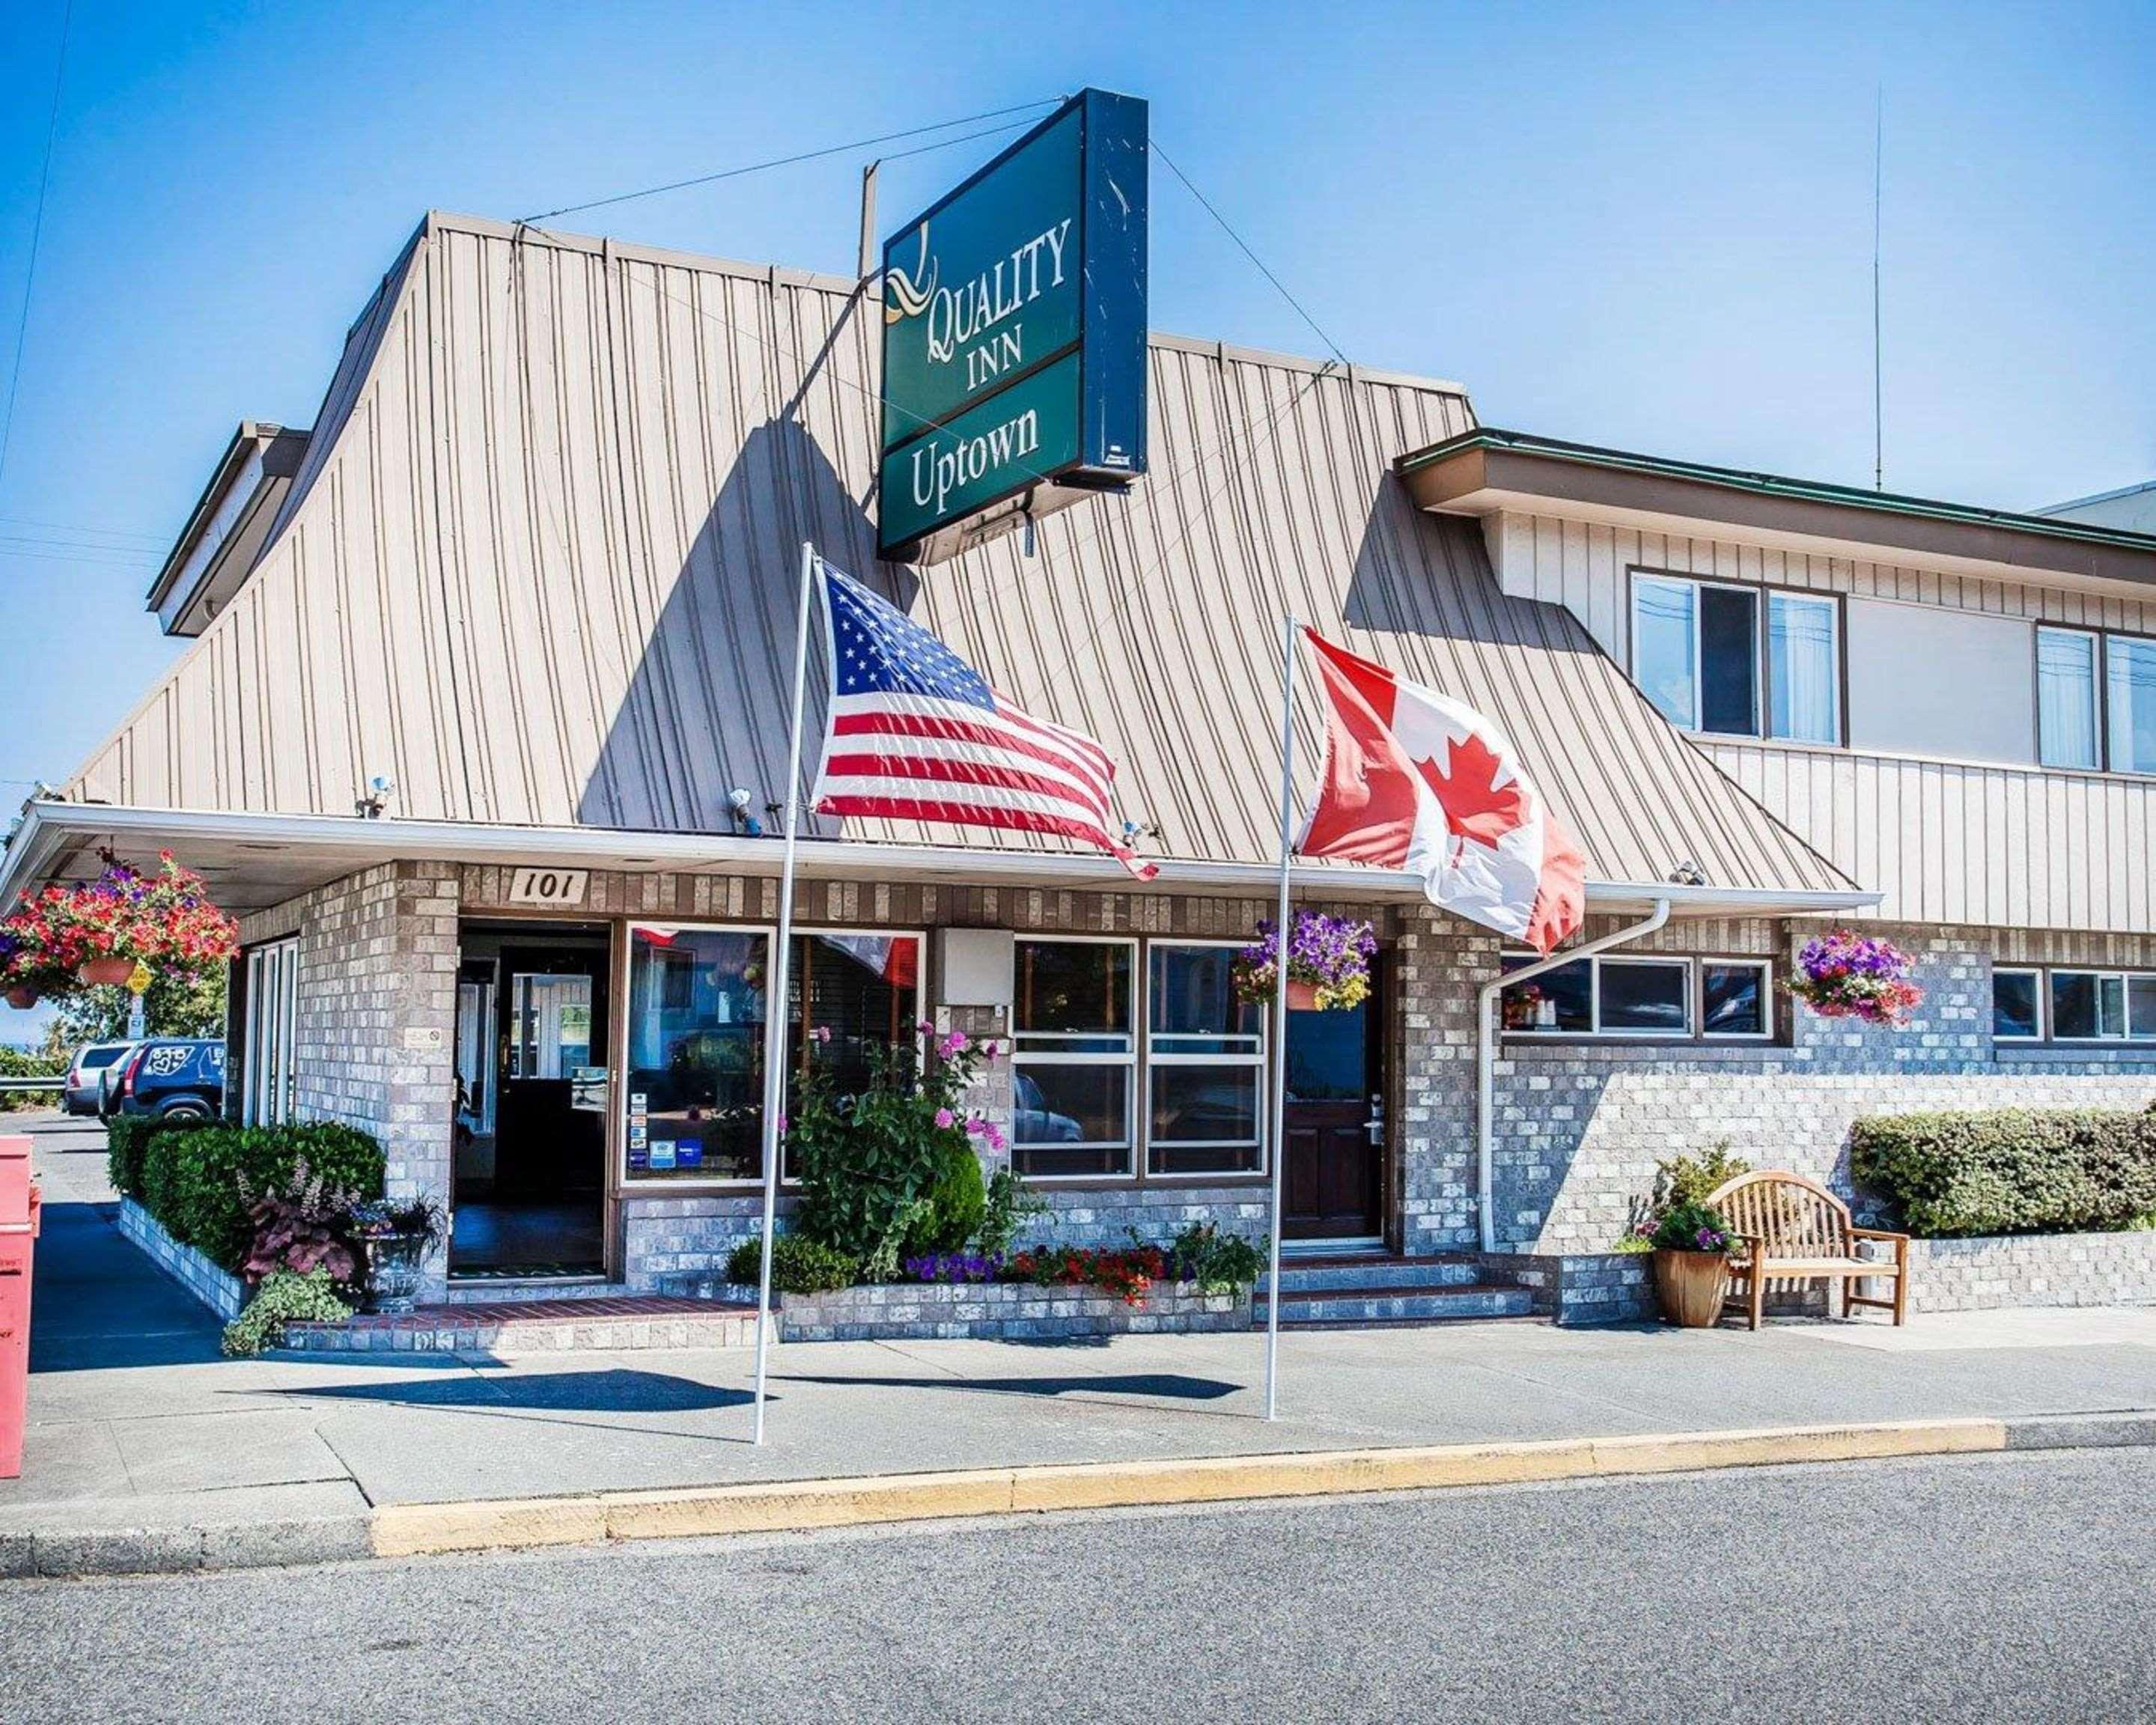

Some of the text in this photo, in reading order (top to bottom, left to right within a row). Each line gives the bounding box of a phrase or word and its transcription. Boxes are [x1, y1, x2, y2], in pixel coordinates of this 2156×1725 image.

[928, 218, 1071, 364] QUALITY
[966, 323, 1022, 391] INN
[912, 409, 1039, 515] Uptown
[525, 873, 573, 898] 101
